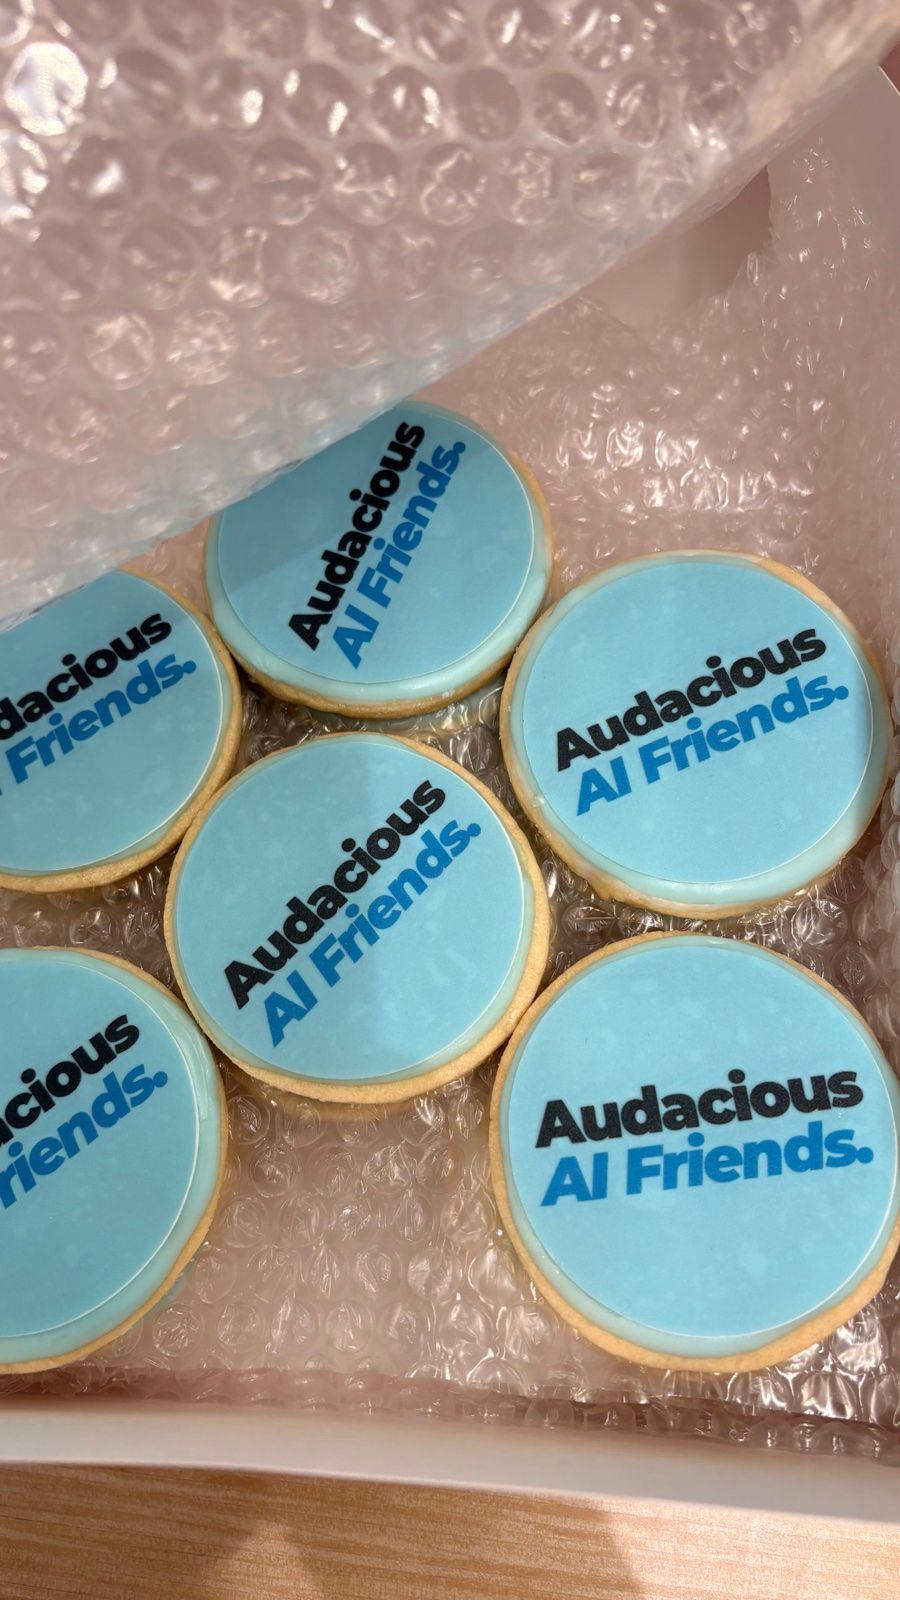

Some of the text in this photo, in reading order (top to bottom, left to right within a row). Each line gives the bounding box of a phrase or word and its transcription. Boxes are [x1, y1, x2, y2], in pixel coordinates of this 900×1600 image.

[288, 421, 425, 651] Audacious
[332, 441, 466, 670] AI Friends.
[6, 654, 196, 785] Friends.
[557, 628, 826, 772] Audacious
[577, 676, 849, 816] AI Friends.
[224, 780, 446, 1010] Audacious
[264, 820, 481, 1048] AI Friends.
[535, 1069, 864, 1148] Audacious
[540, 1120, 874, 1207] AI Friends.
